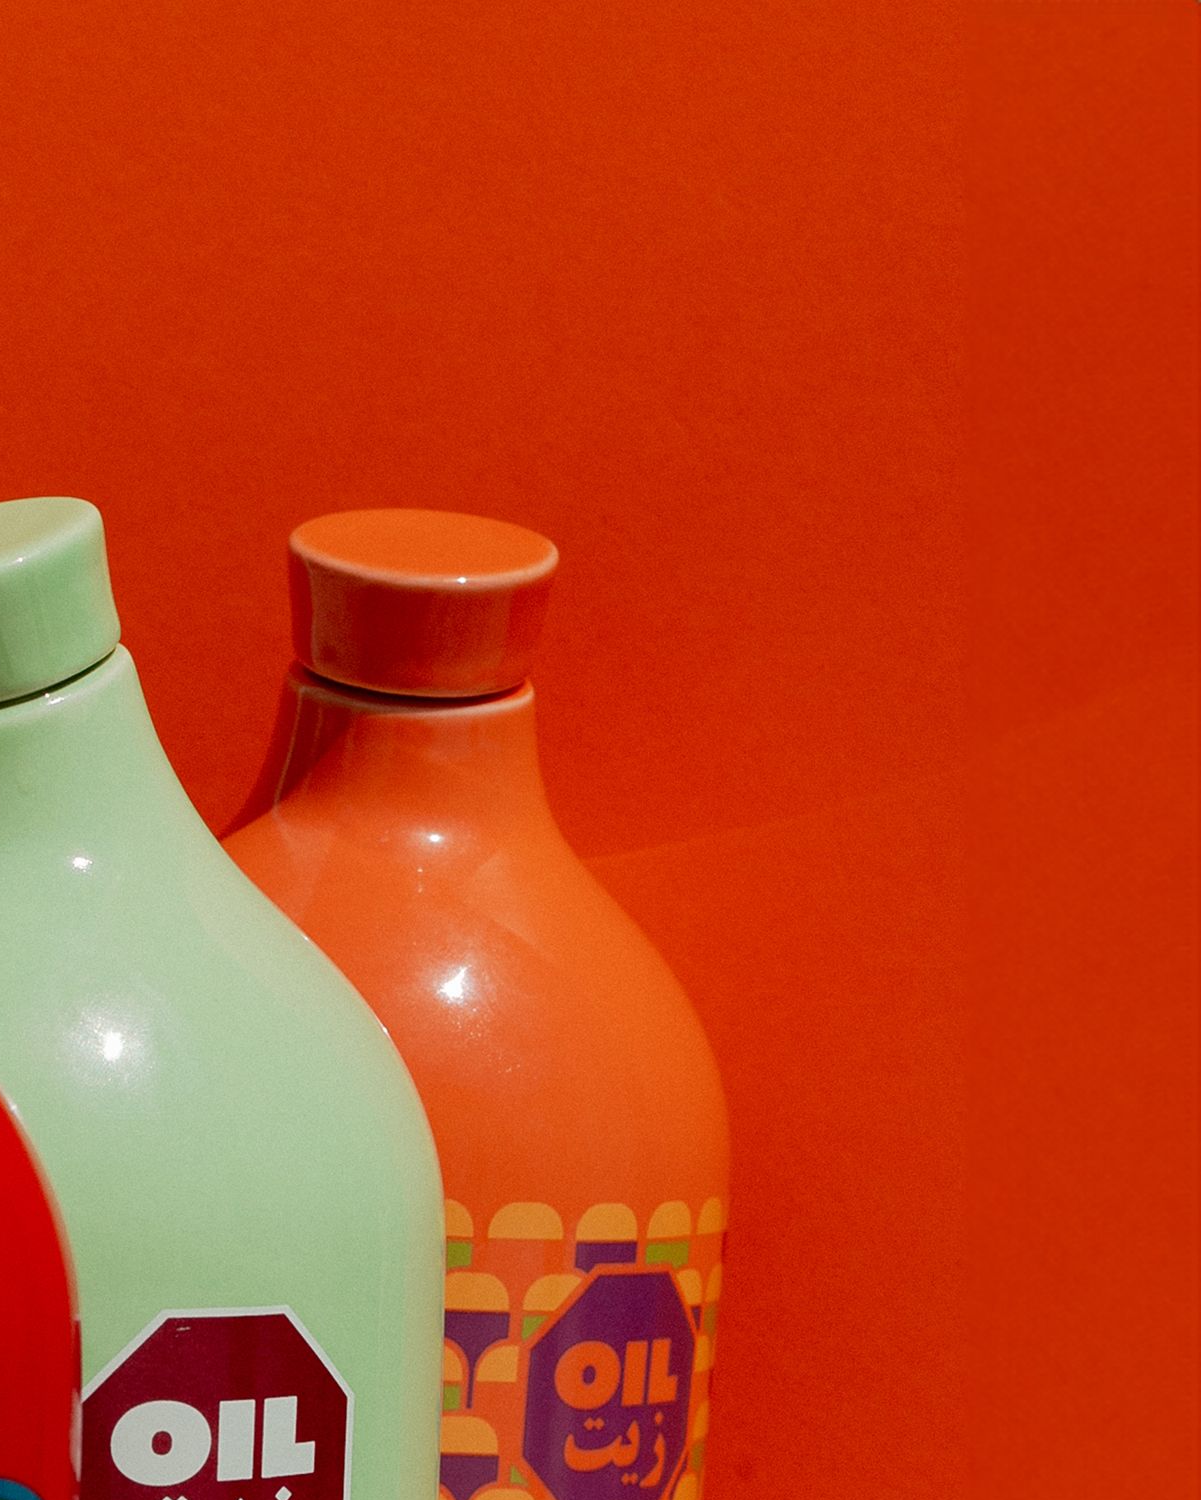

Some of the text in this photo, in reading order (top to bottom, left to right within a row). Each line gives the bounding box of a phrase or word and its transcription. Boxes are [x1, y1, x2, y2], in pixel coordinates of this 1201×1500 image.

[554, 1338, 678, 1410] OIL
[110, 1396, 316, 1487] OIL
[563, 1411, 666, 1488] زيت
